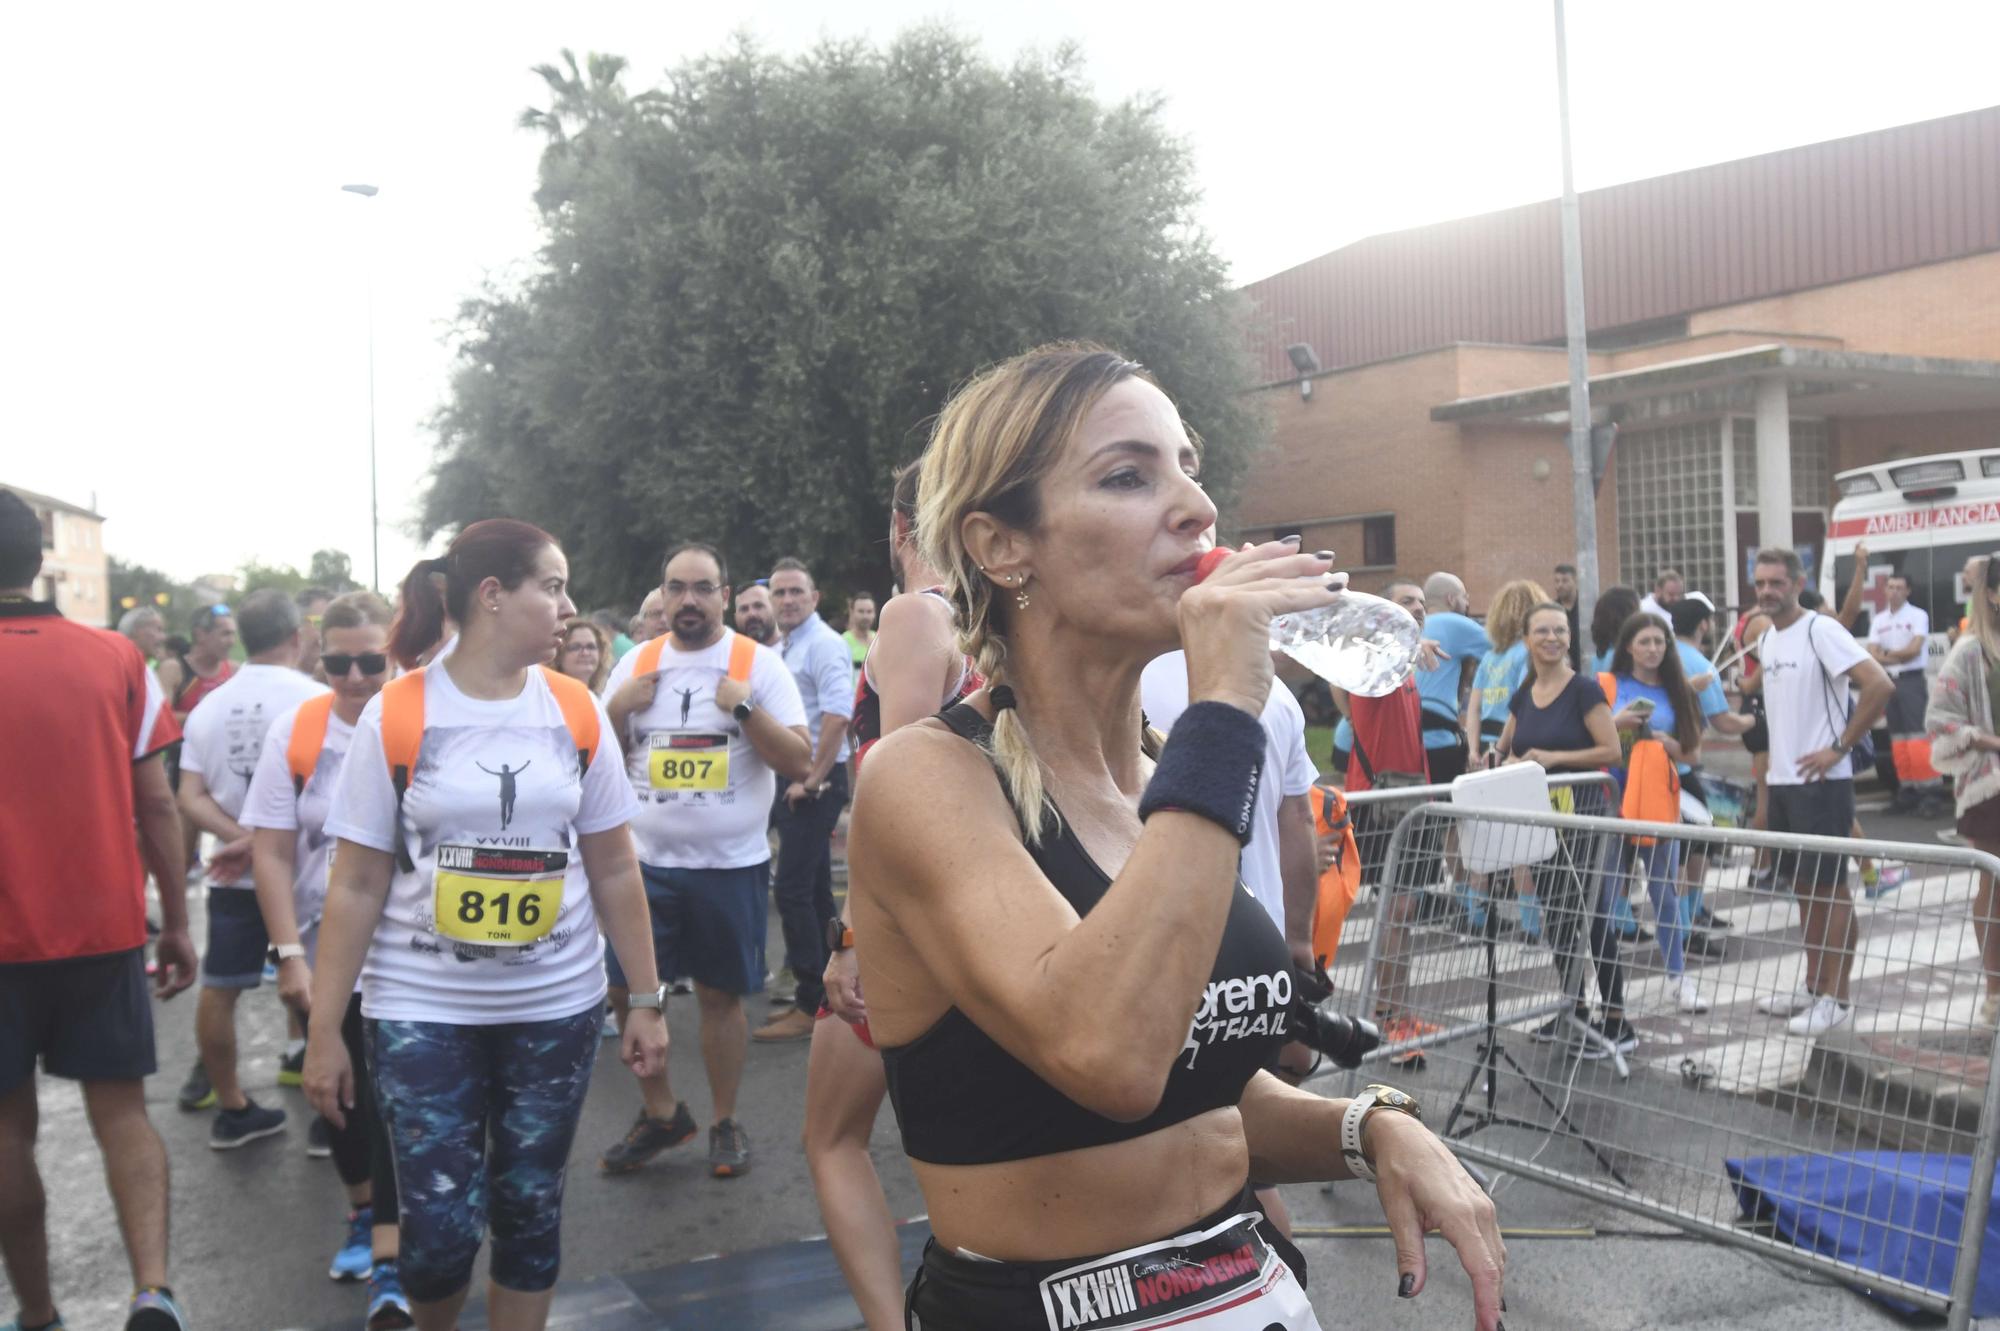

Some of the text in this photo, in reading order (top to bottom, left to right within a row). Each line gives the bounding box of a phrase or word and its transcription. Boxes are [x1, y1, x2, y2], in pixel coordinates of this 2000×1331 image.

[1866, 503, 2000, 537] AMBULANCIA
[662, 759, 713, 779] 807
[457, 890, 541, 926] 816
[1207, 1011, 1287, 1045] TRAIL
[1051, 1264, 1137, 1329] XXVIII
